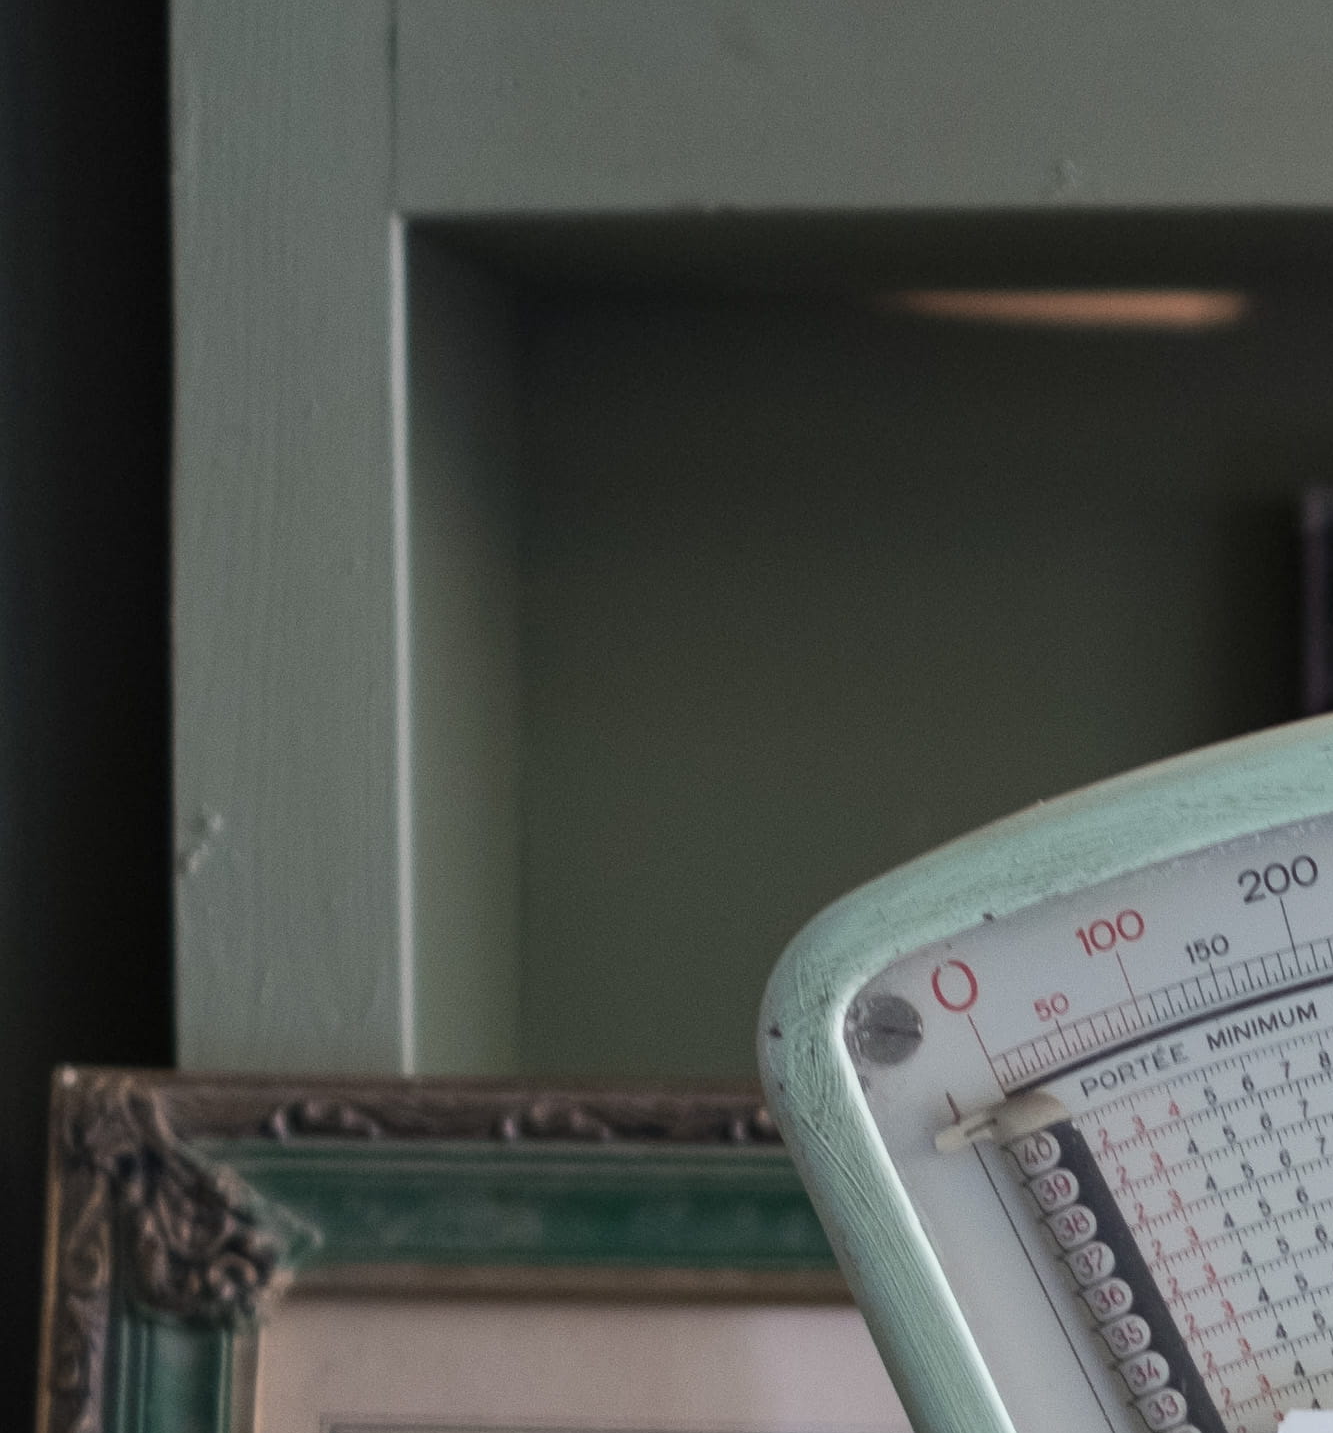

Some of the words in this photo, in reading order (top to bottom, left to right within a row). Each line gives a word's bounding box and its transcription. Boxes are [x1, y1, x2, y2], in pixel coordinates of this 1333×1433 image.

[931, 958, 980, 1014] 0
[1074, 908, 1146, 956] 100
[1236, 854, 1319, 904] 200
[1033, 992, 1071, 1022] 50
[1184, 934, 1231, 965] 150
[1079, 1041, 1190, 1098] PORTÉE
[1205, 1002, 1319, 1054] MINIMUM
[1098, 1127, 1112, 1151] 2
[1131, 1114, 1146, 1137] 3
[1167, 1099, 1181, 1118] 4
[1203, 1086, 1218, 1107] 5
[1241, 1073, 1255, 1093] 6
[1280, 1060, 1291, 1080] 7
[1318, 1050, 1332, 1070] 8
[1022, 1130, 1052, 1166] 40
[1038, 1175, 1072, 1205] 39
[1056, 1210, 1091, 1241] 38
[1075, 1246, 1104, 1277] 37
[1094, 1284, 1126, 1315] 36
[1111, 1320, 1144, 1350] 35
[1128, 1357, 1160, 1388] 34
[1150, 1394, 1179, 1424] 33
